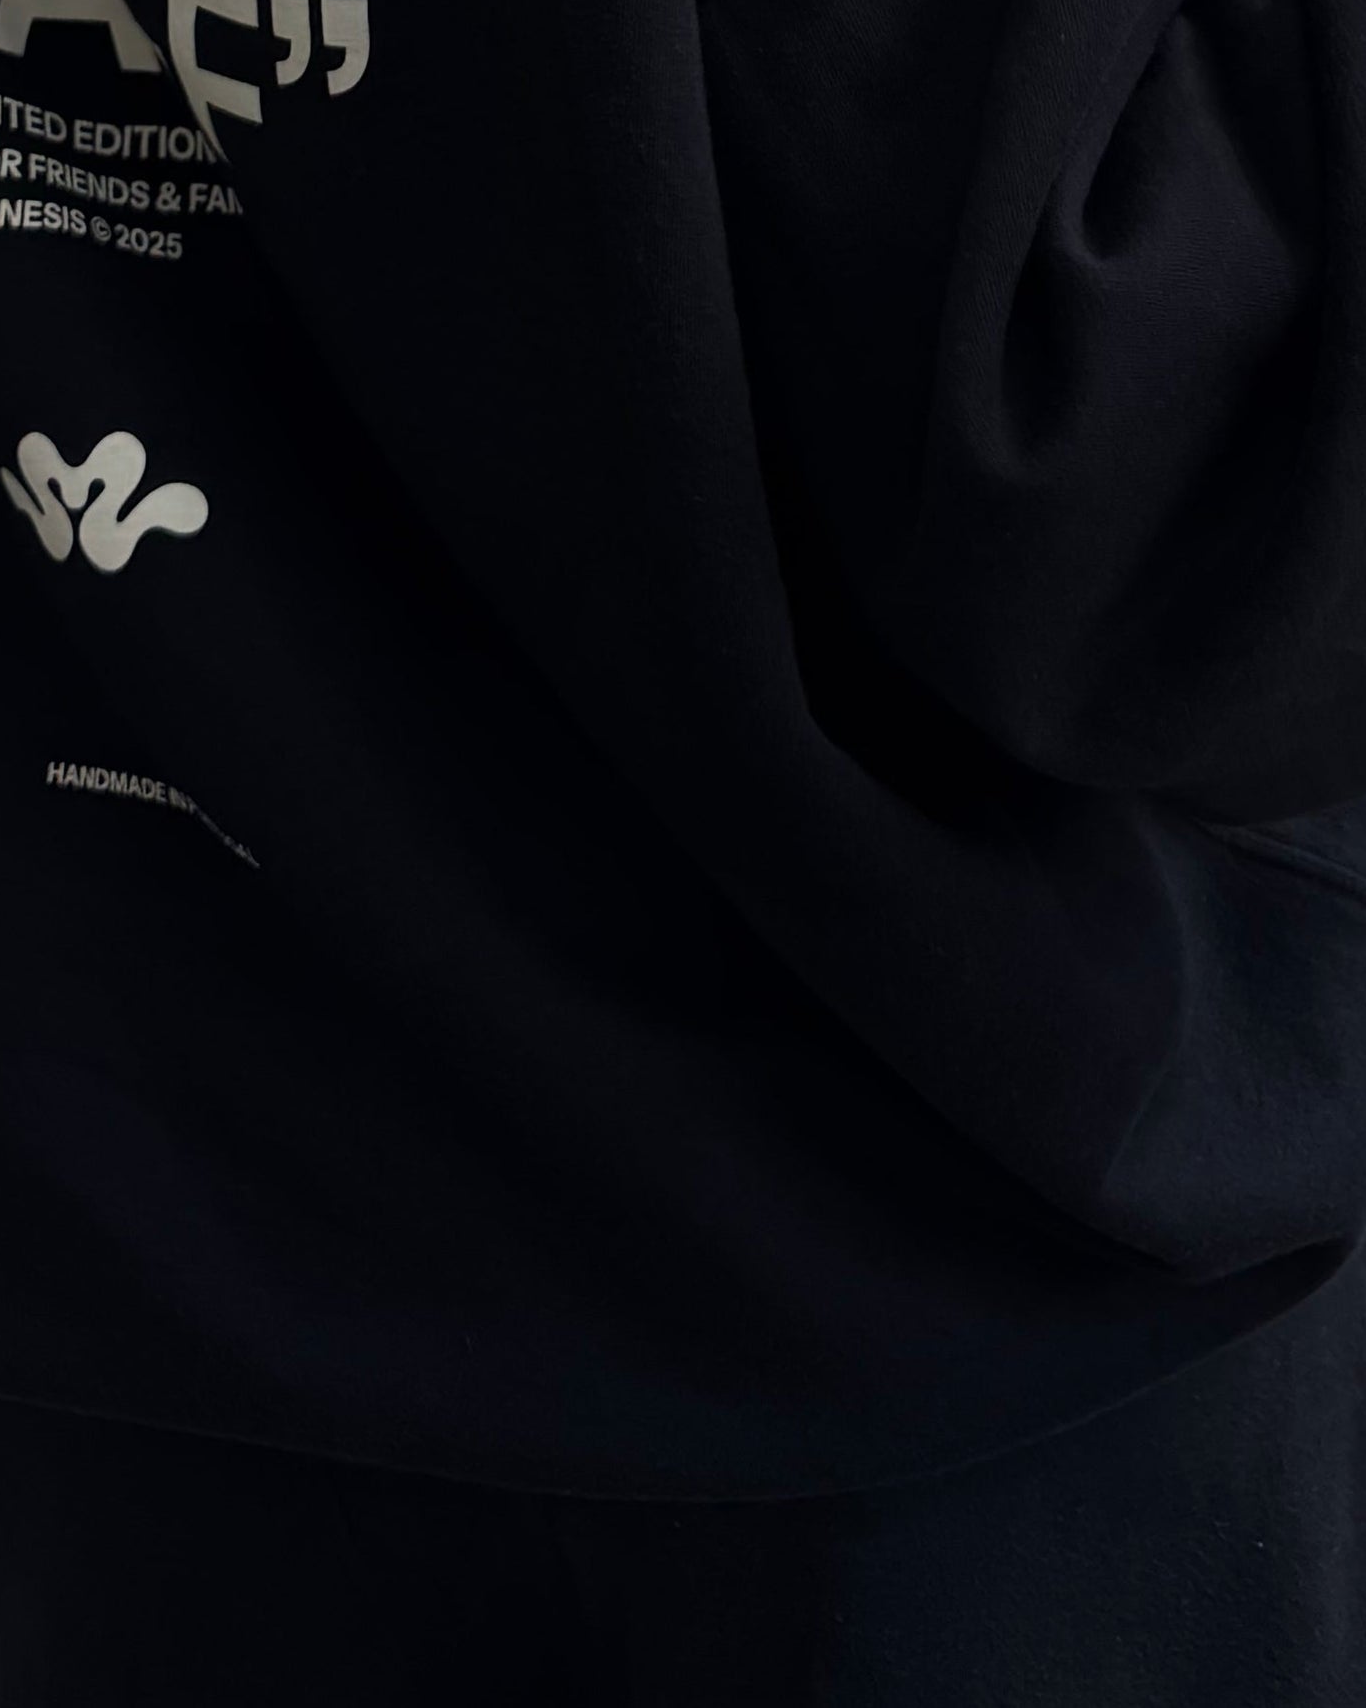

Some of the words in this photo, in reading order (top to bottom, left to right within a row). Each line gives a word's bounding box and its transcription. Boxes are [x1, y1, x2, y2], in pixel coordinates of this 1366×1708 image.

[28, 152, 150, 213] FRIENDS
[154, 181, 182, 213] &
[115, 225, 184, 260] 2025
[46, 761, 168, 803] HANDMADE
